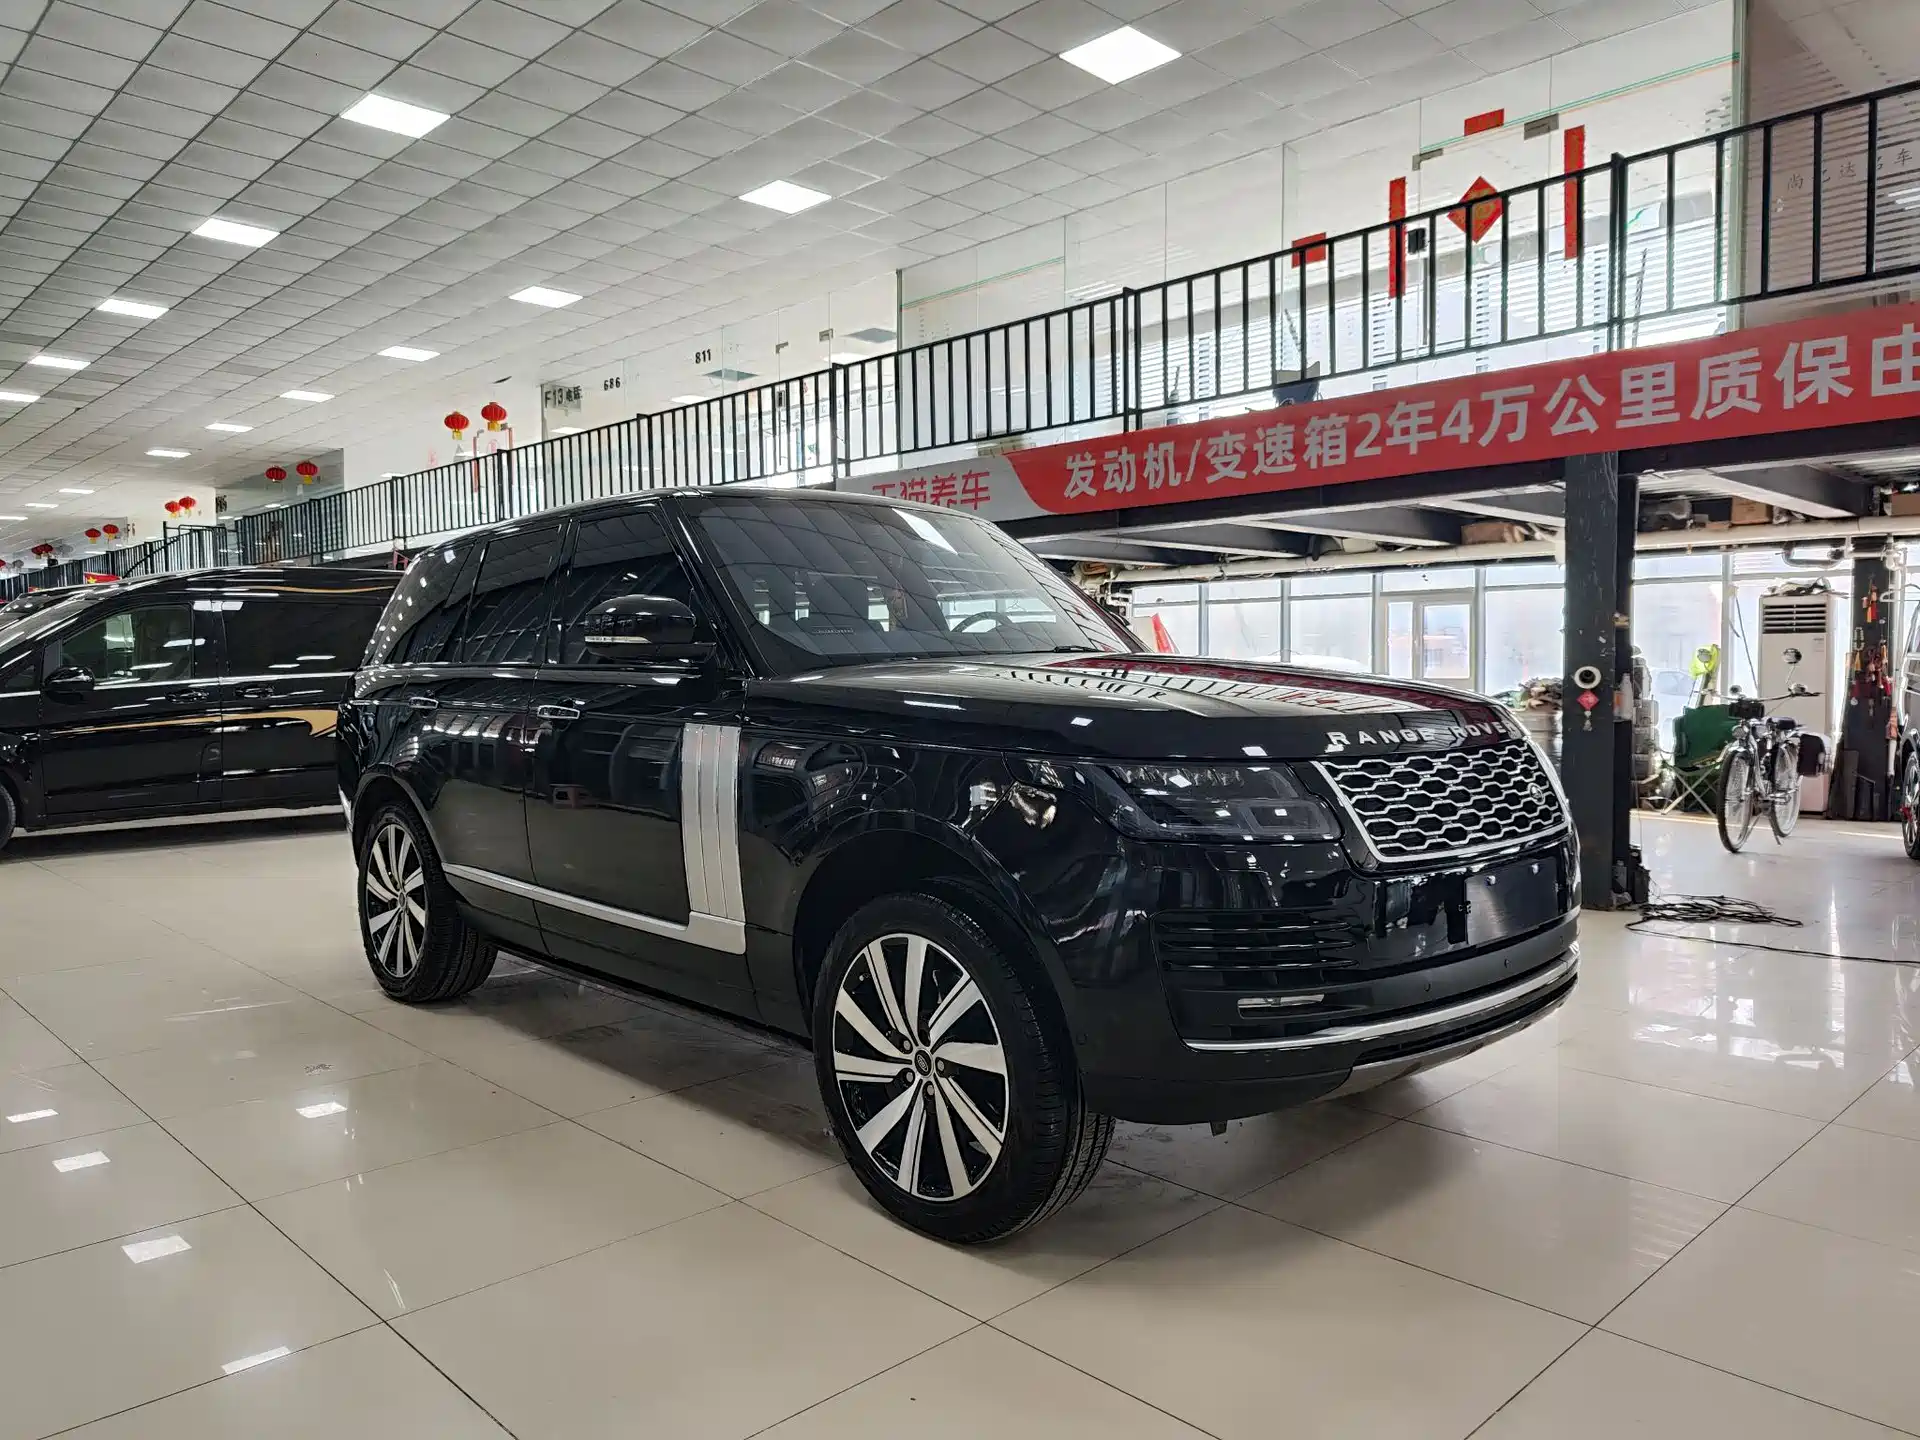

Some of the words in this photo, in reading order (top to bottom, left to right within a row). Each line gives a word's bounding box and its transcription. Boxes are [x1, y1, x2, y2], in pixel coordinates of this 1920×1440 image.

[1787, 148, 1913, 191] 尚达车
[603, 377, 621, 391] 686
[695, 348, 711, 364] 811
[1063, 323, 1920, 499] 发动机/变速箱2年4万公里质保由
[1326, 727, 1435, 746] RANGE
